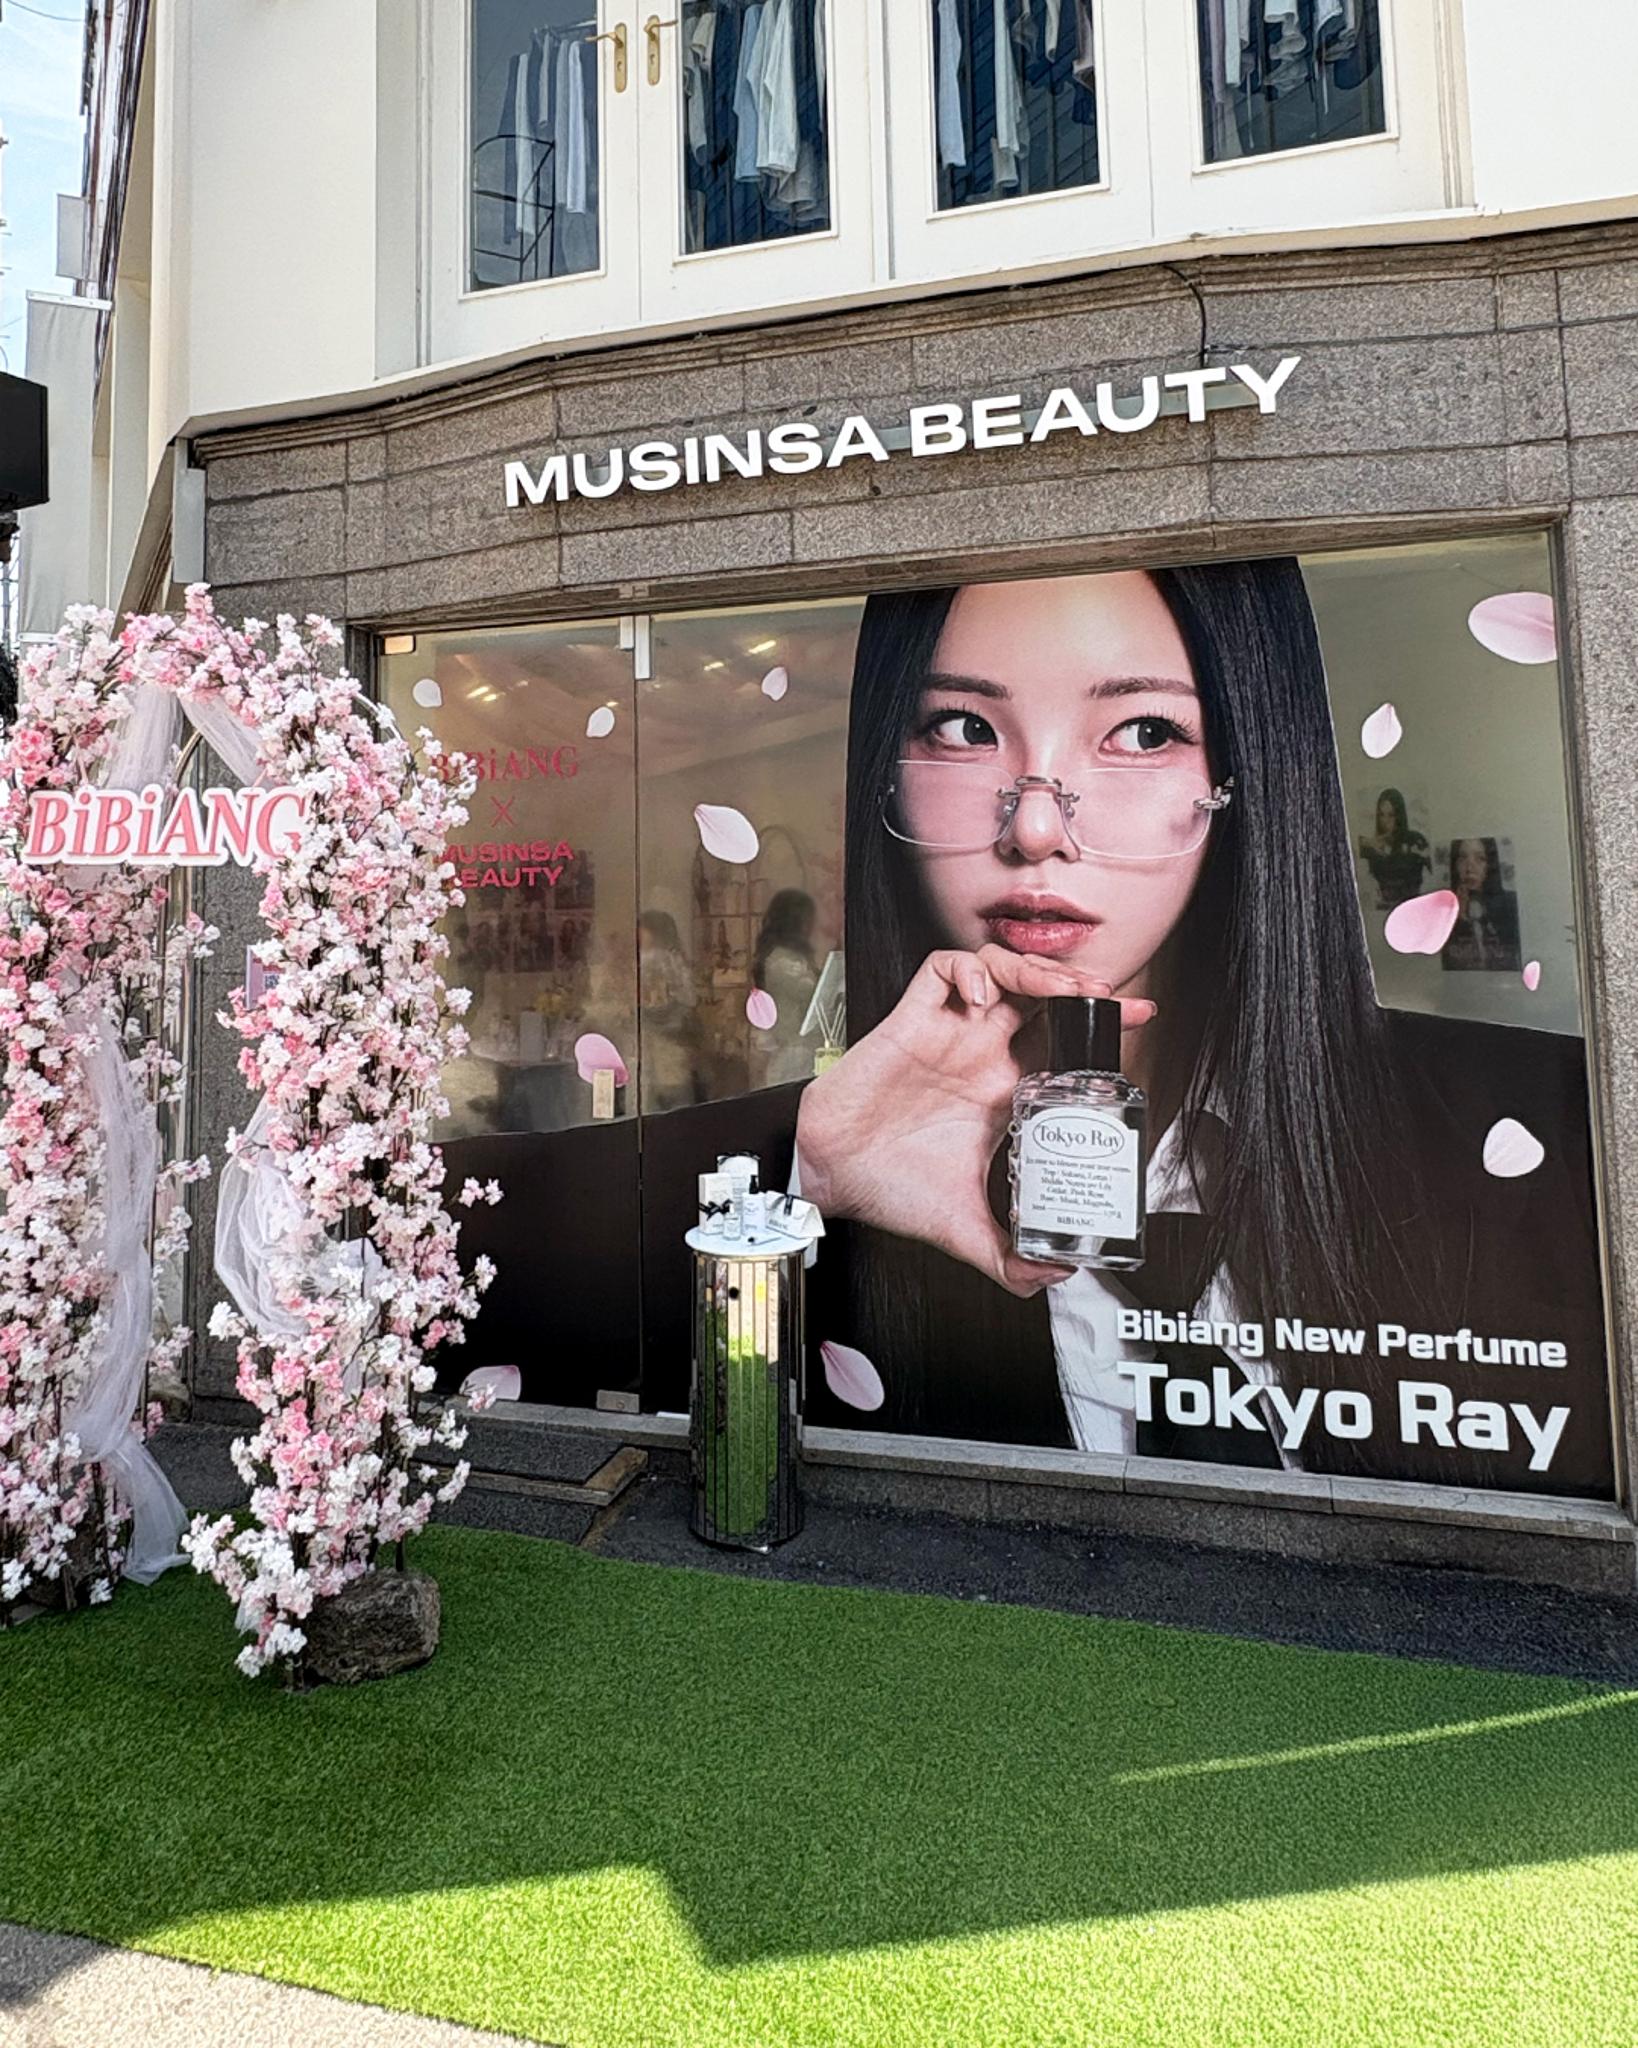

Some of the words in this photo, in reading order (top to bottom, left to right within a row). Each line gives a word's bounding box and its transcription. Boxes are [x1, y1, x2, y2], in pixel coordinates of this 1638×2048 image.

[504, 415, 889, 507] MUSINSA
[910, 356, 1301, 457] BEAUTY
[26, 791, 306, 858] BiBiANG
[455, 865, 564, 889] EAUTY
[1038, 1125, 1087, 1147] Tokyo
[1091, 1129, 1120, 1153] Ray
[1117, 1308, 1264, 1357] Bibiang
[1274, 1318, 1366, 1355] New
[1377, 1323, 1568, 1368] Perfume
[1117, 1361, 1373, 1450] Tokyo
[1398, 1380, 1571, 1472] Ray
